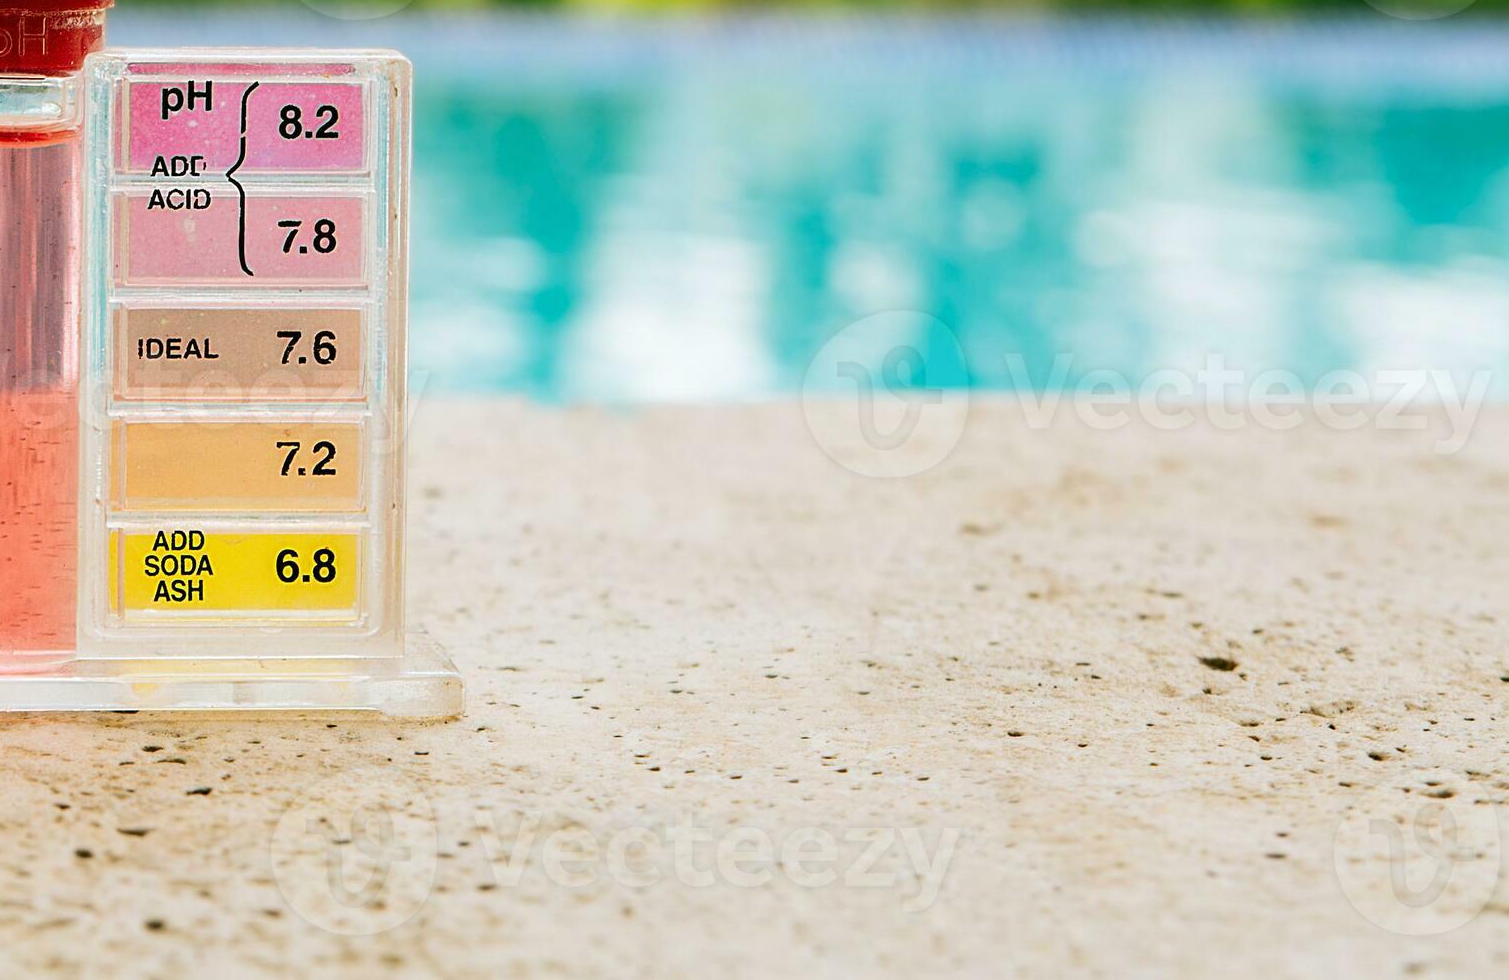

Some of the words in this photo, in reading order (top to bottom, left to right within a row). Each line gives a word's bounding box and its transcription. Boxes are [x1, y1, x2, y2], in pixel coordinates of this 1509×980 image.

[161, 81, 213, 119] pH
[278, 105, 339, 139] 8.2
[150, 156, 206, 177] ADD
[147, 189, 212, 210] ACID
[277, 219, 337, 253] 7.8
[137, 337, 219, 360] IDEAL
[276, 331, 337, 365] 7.6
[276, 441, 337, 476] 7.2
[152, 531, 205, 552] ADD
[144, 555, 214, 577] SODA
[275, 549, 337, 583] 6.8
[153, 580, 204, 602] ASH
